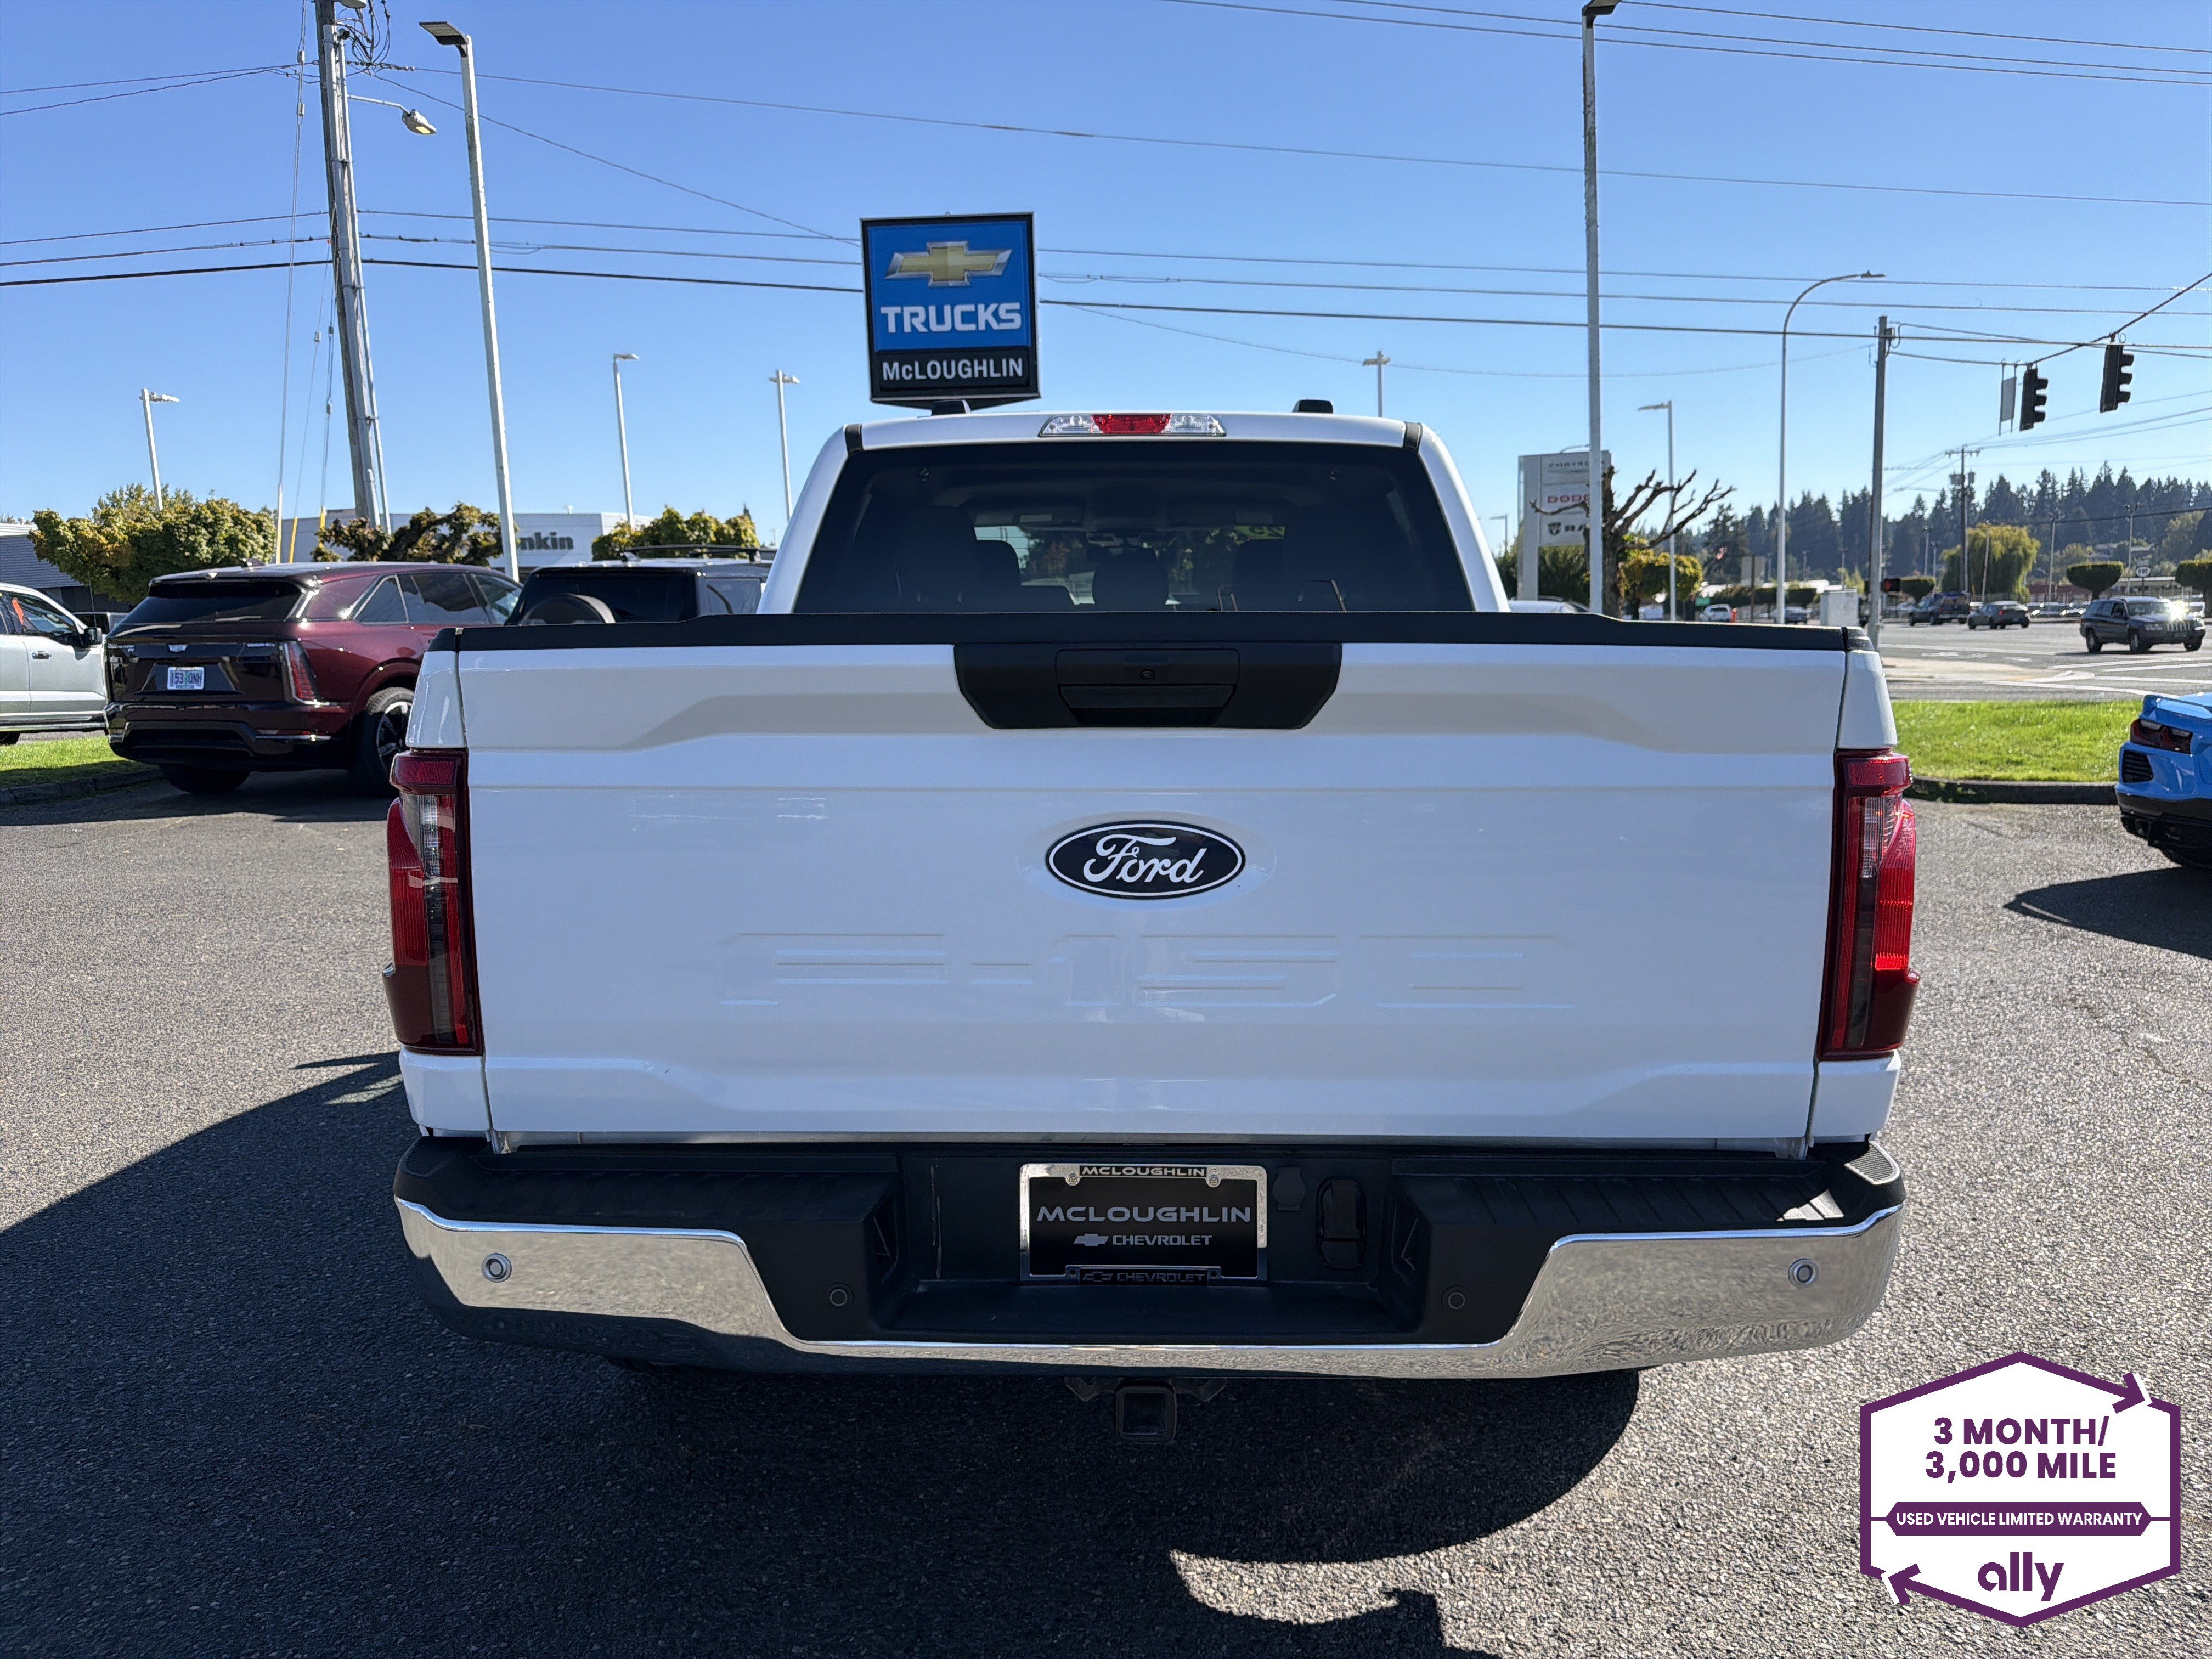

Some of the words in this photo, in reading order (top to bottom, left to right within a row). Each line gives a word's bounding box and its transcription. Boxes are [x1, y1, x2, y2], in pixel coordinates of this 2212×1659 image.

[881, 302, 1022, 333] TRUCKS
[882, 358, 1023, 381] McLOUGHLIN
[1083, 834, 1207, 883] Ford
[719, 933, 1576, 1008] F-150
[1082, 1166, 1205, 1176] MCLOUGHLIN
[1036, 1206, 1251, 1222] MCLOUGHLIN
[1112, 1234, 1213, 1245] CHEVROLET
[1116, 1272, 1205, 1282] CHEVROLET
